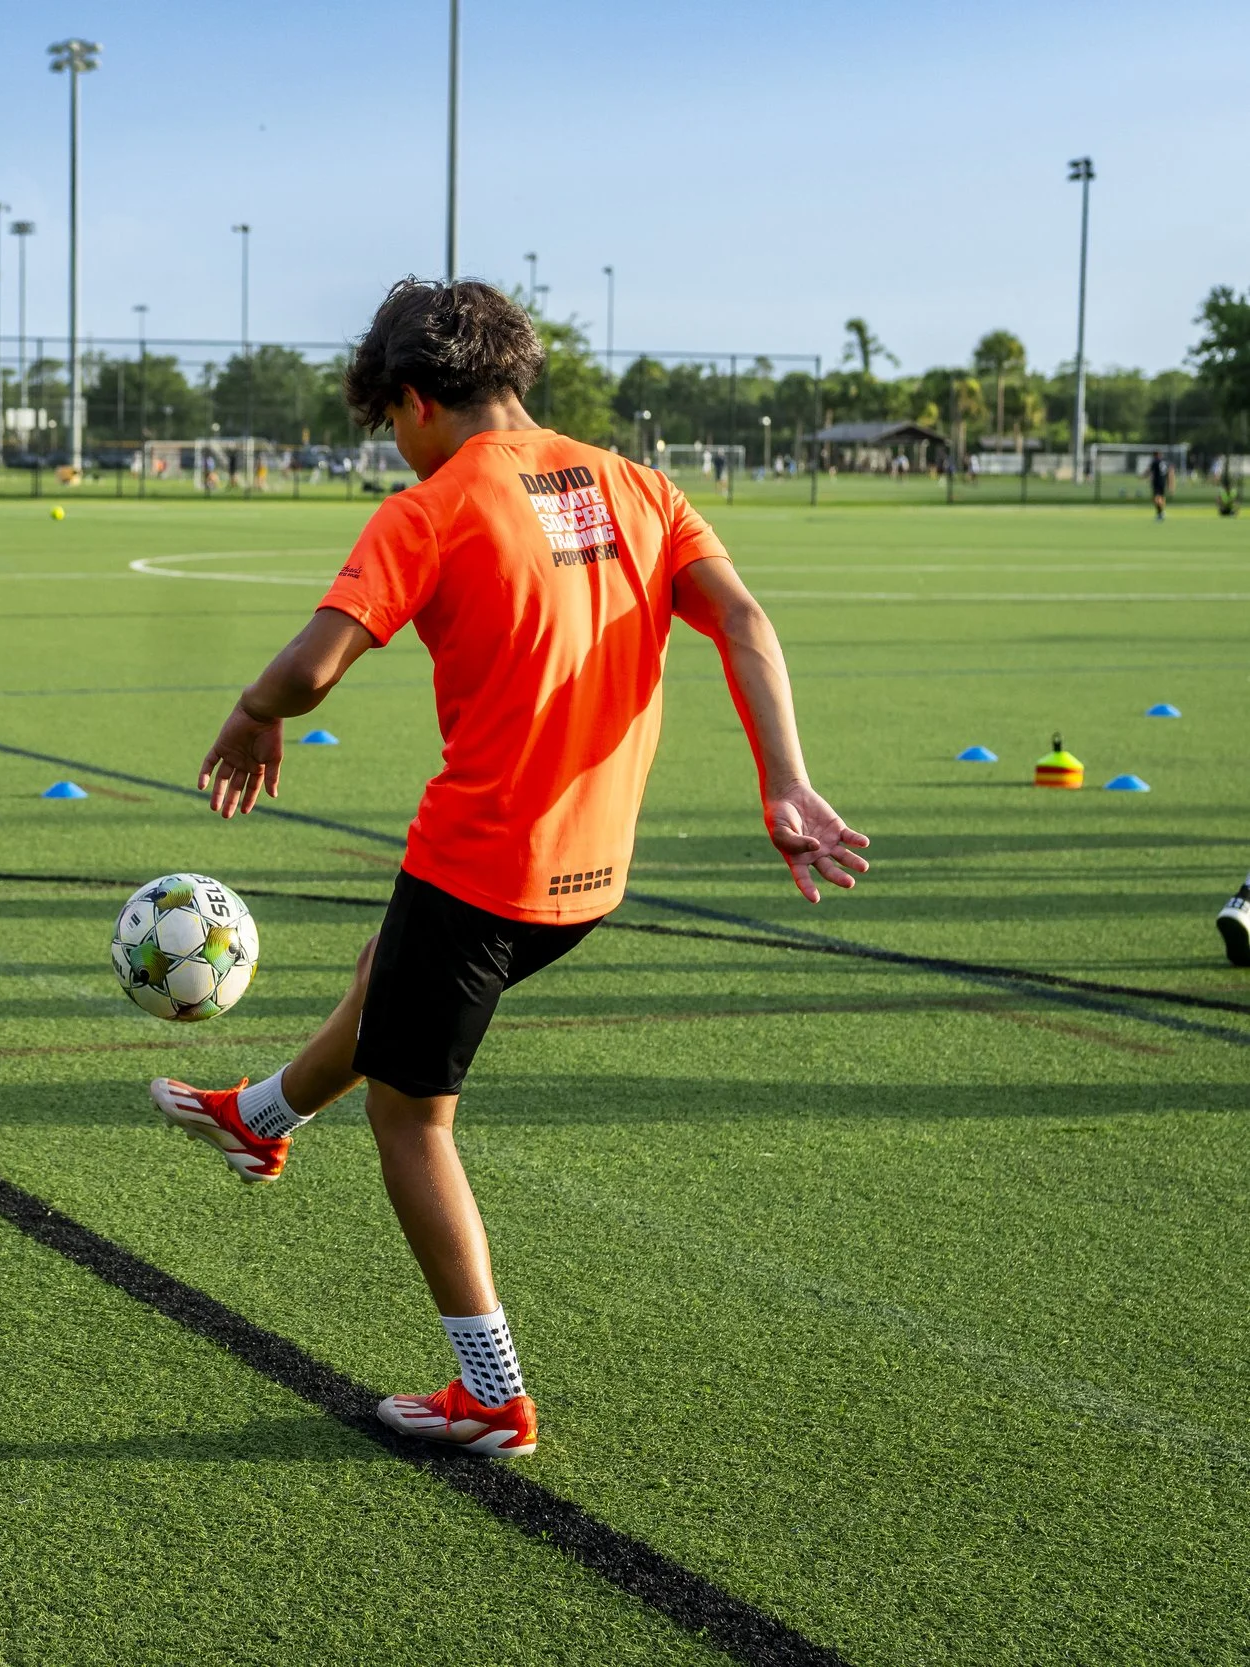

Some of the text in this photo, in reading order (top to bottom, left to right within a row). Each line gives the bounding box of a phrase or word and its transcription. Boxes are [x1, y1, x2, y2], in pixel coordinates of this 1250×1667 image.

[518, 466, 595, 494] DAVID
[529, 486, 603, 513] PRIVATE
[538, 503, 611, 533] SOCCER
[545, 523, 616, 550] TRAINING
[551, 543, 620, 567] POPOVSKI
